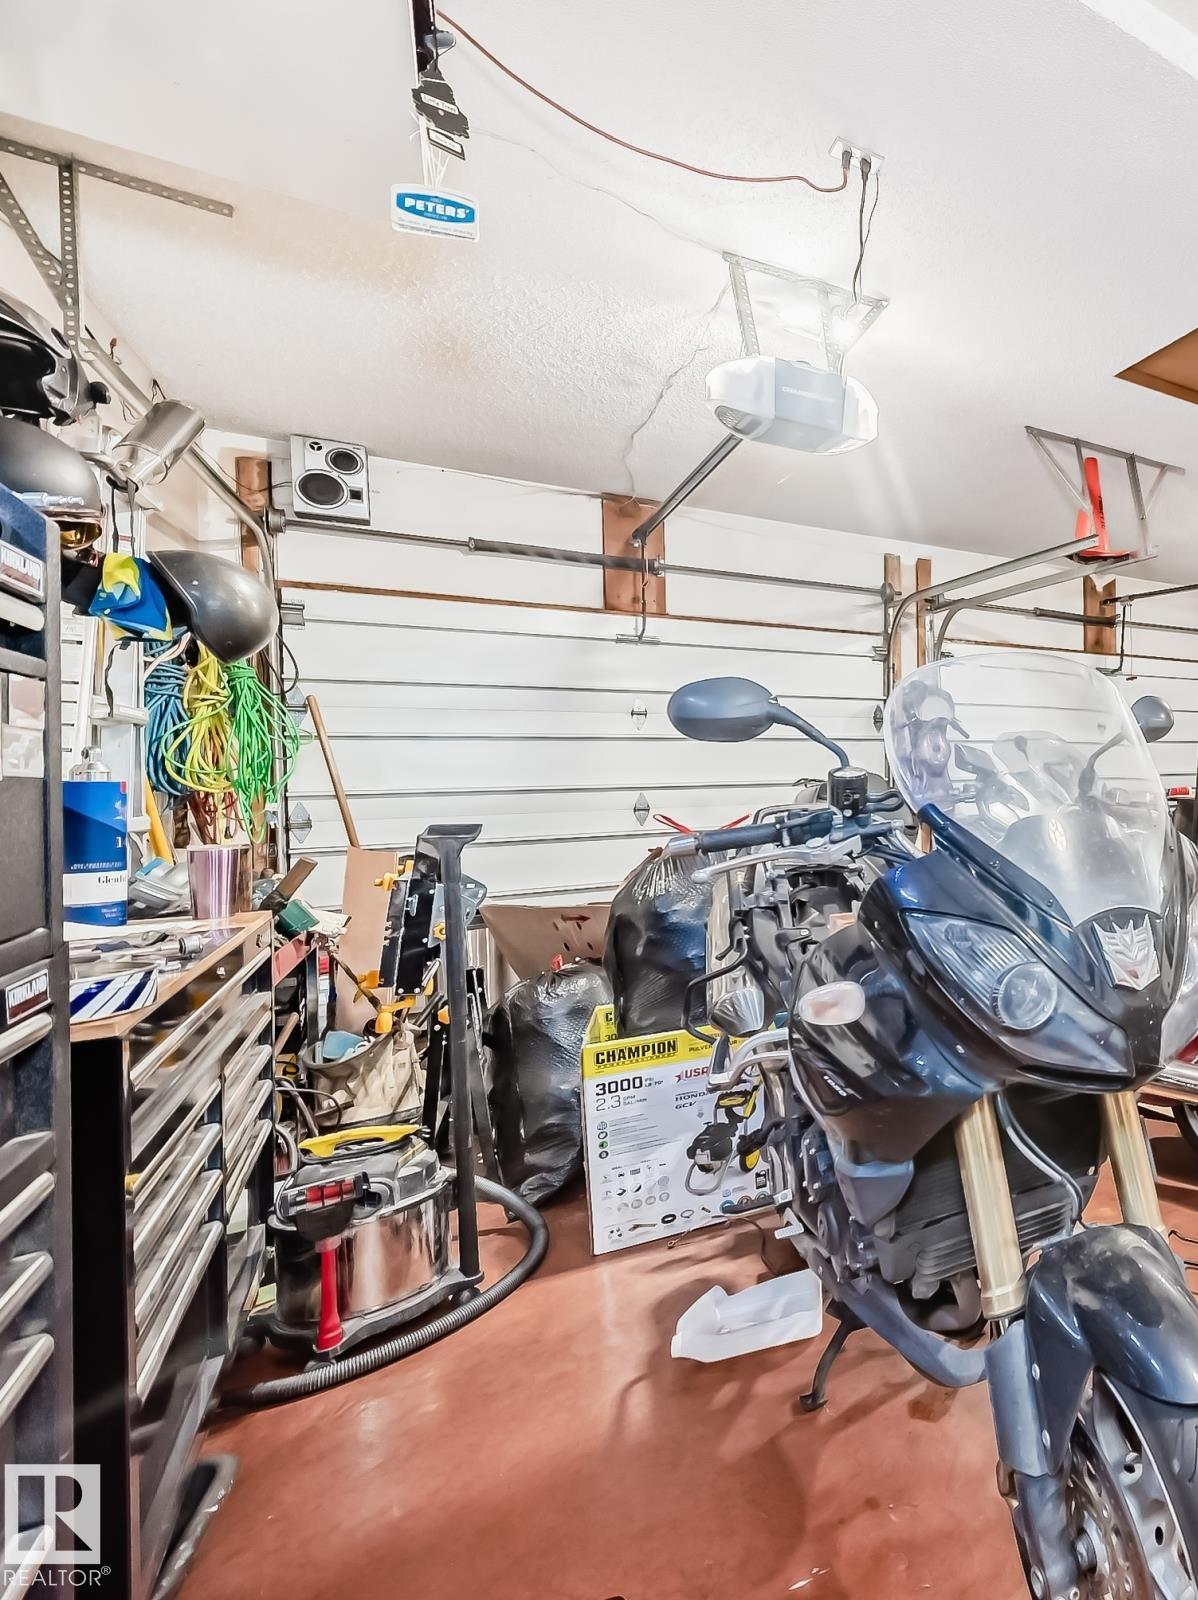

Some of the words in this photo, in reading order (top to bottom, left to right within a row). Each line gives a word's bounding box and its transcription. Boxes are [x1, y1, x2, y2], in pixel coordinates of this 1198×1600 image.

[404, 197, 469, 219] PETERS'
[595, 1039, 676, 1065] CHAMPION
[595, 1076, 643, 1096] 3000
[595, 1095, 621, 1112] 2.3
